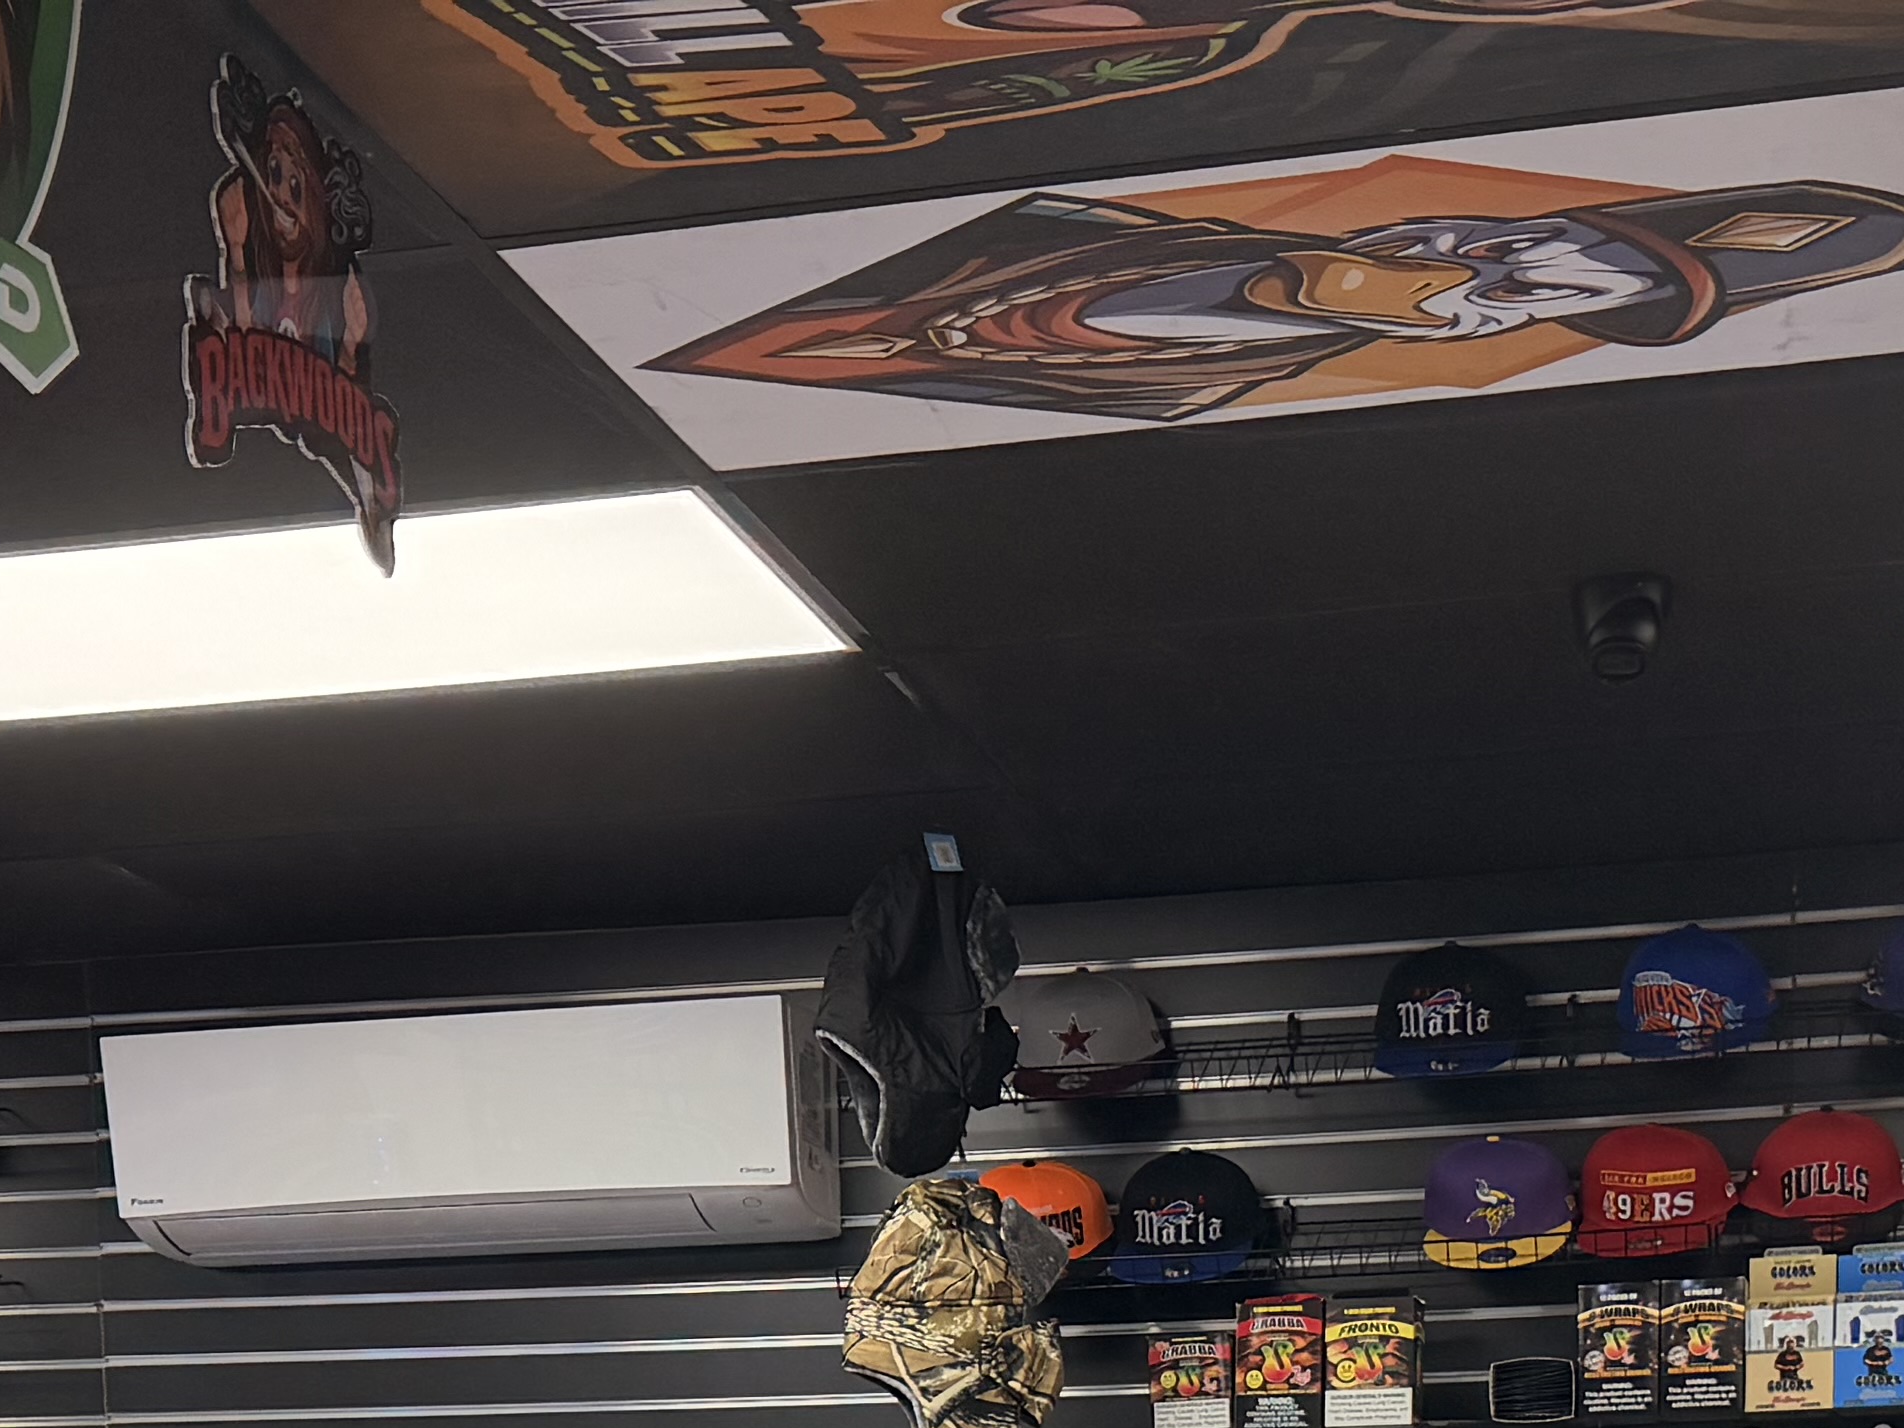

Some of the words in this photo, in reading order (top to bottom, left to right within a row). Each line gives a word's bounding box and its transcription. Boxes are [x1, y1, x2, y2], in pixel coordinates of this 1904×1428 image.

[194, 330, 399, 502] BACKWOODS
[1398, 1003, 1492, 1039] Mafia
[1782, 1161, 1869, 1208] BULLS
[1603, 1190, 1694, 1222] 49ERS
[1134, 1206, 1223, 1246] Mafia
[1338, 1321, 1400, 1337] FRONTO
